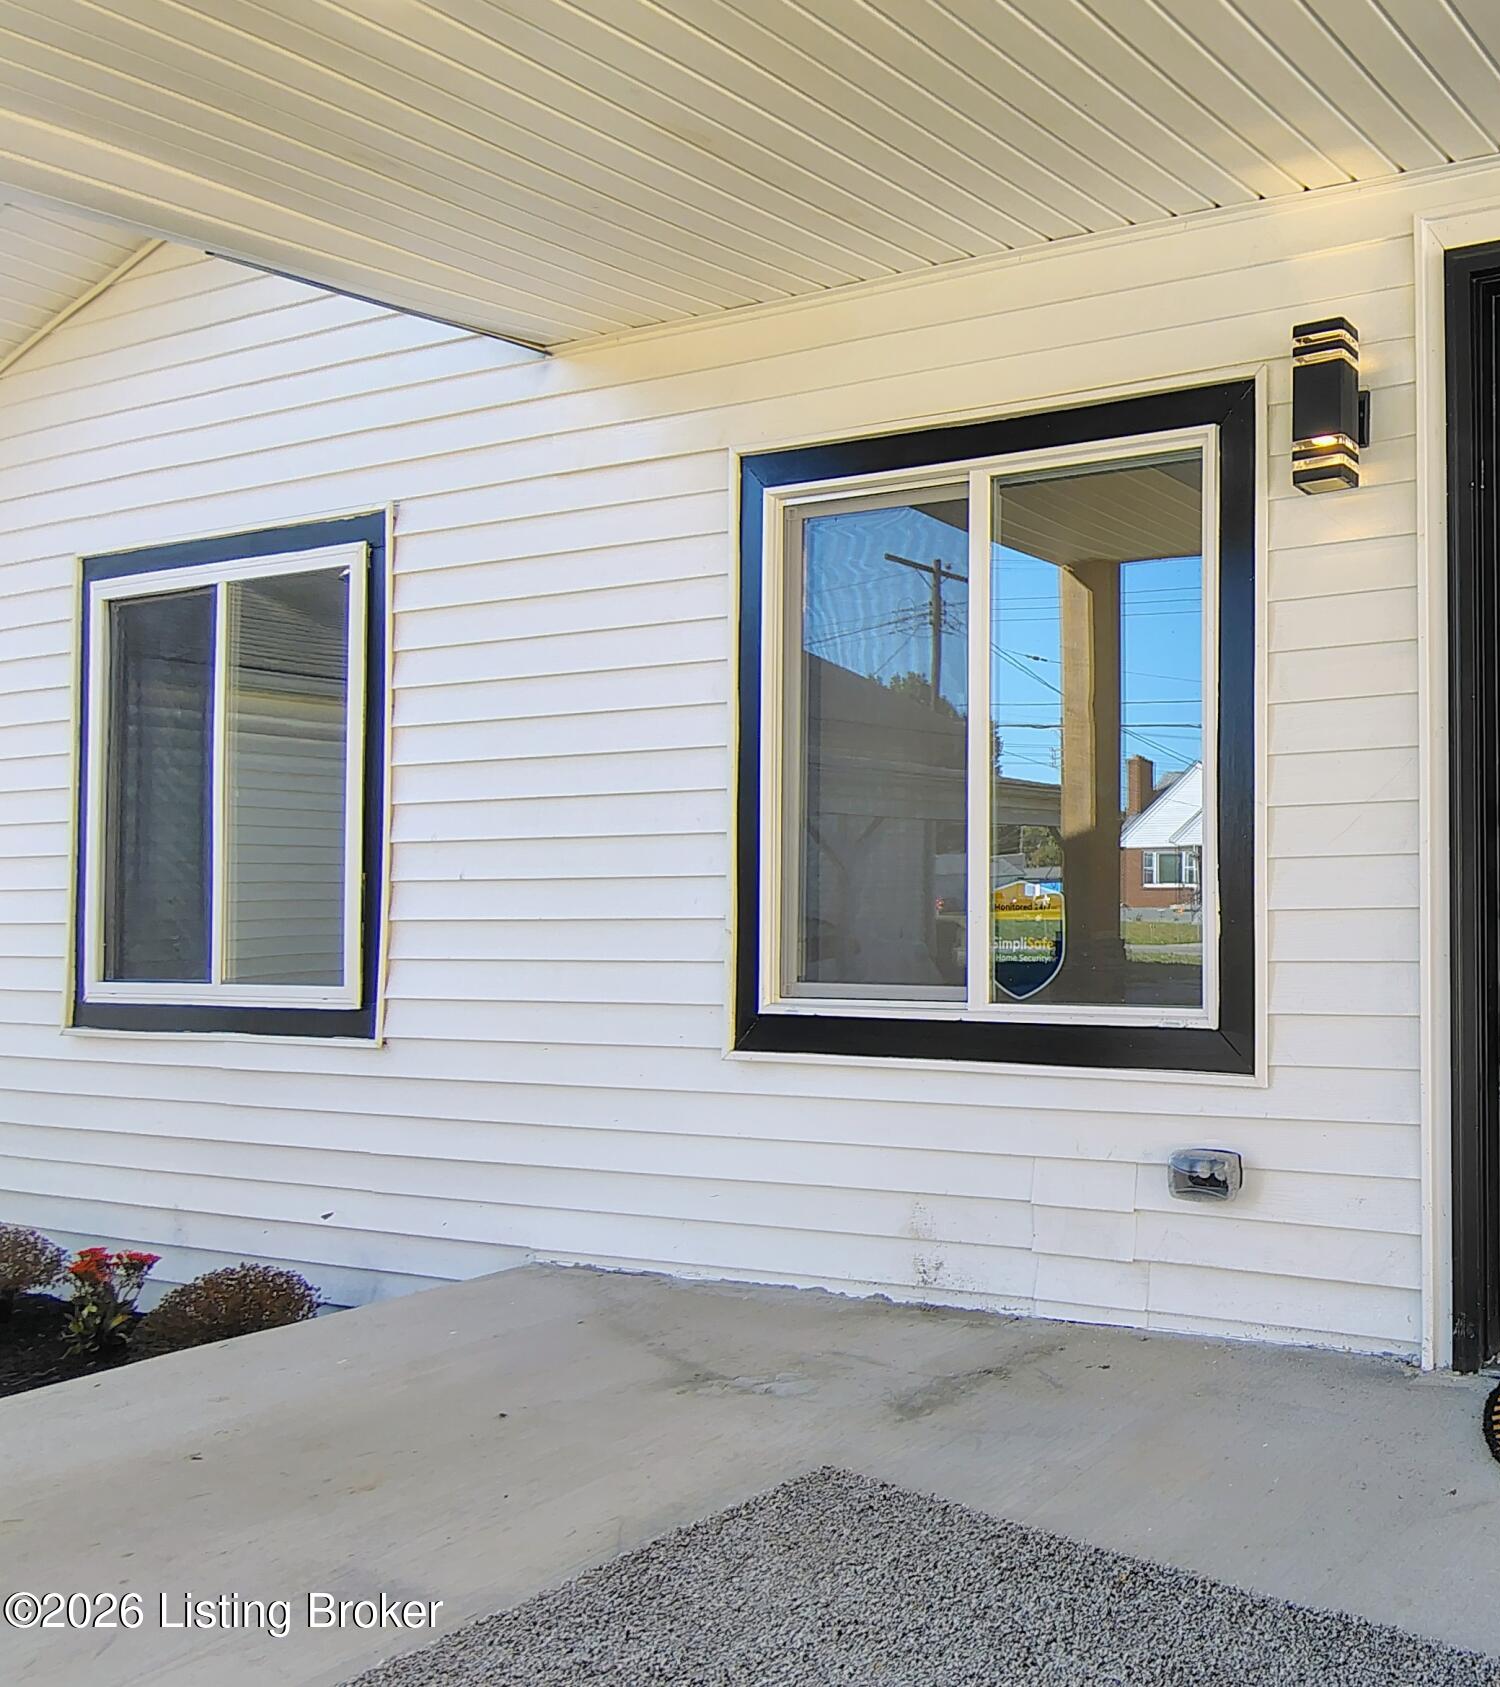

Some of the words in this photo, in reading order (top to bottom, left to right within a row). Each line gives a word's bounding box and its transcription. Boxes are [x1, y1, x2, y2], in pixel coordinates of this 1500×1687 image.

[995, 902, 1033, 911] Monitored
[993, 936, 1054, 952] SimpliSafe
[995, 954, 1018, 962] Home
[1019, 954, 1050, 964] Security
